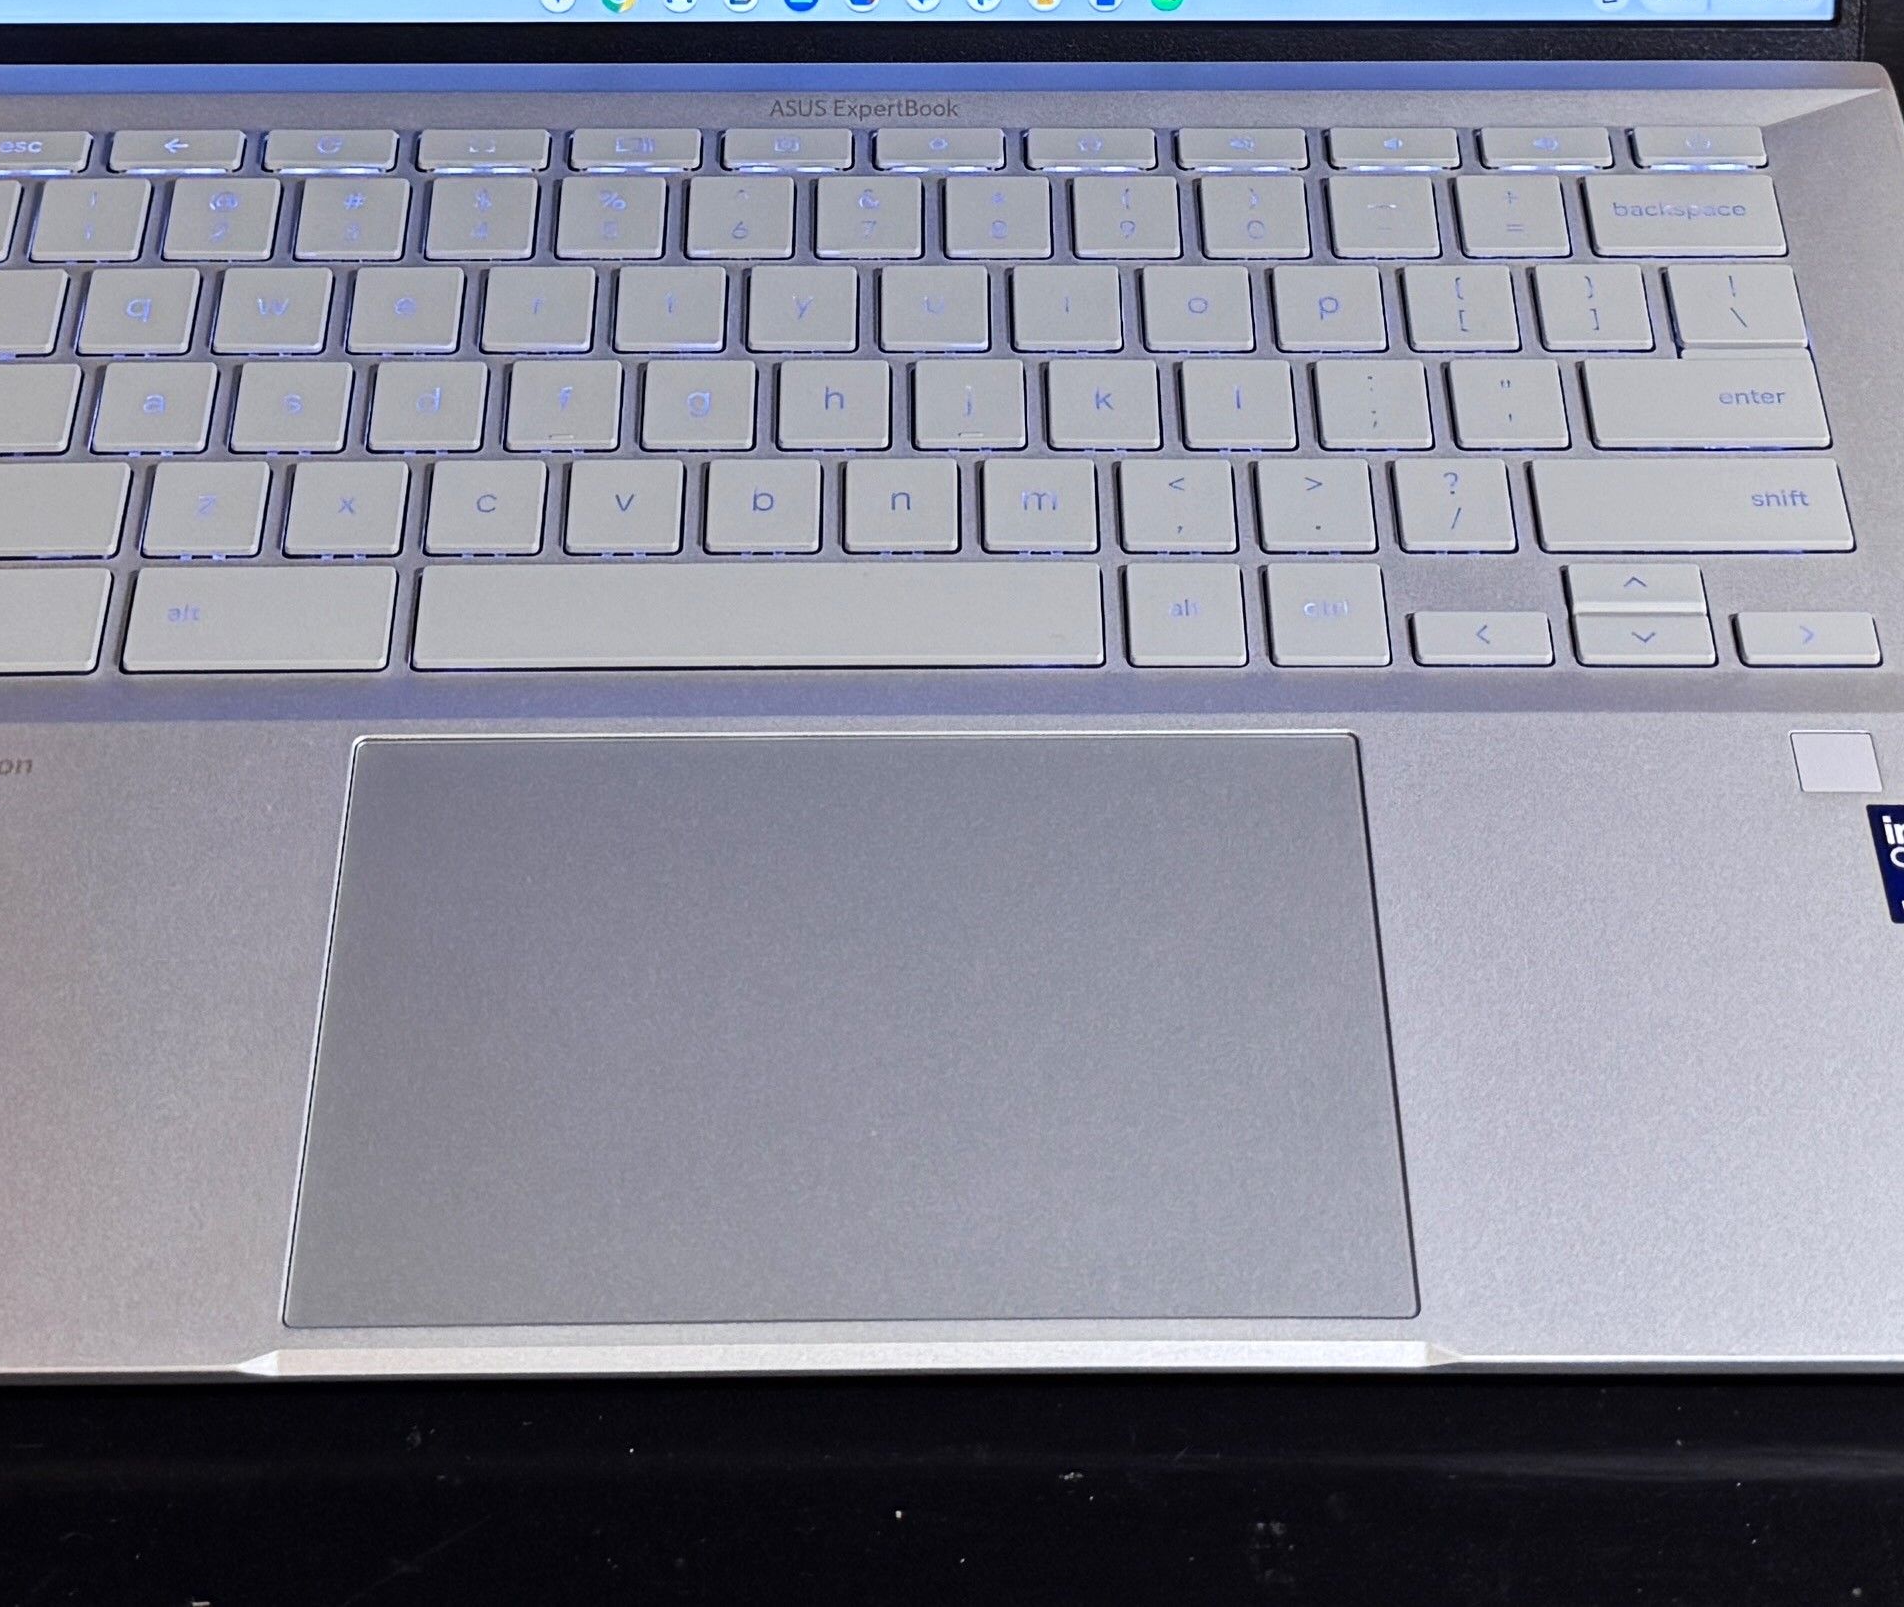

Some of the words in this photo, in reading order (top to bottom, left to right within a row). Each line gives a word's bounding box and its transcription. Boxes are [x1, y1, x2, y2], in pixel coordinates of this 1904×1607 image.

[769, 99, 827, 118] ASUS
[833, 98, 960, 122] ExpertBook
[0, 140, 43, 154] esc
[1612, 200, 1747, 221] backspace
[732, 220, 749, 240] 6
[126, 298, 153, 323] q
[792, 292, 813, 320] y
[1319, 296, 1339, 321] p
[142, 392, 167, 414] a
[416, 387, 442, 414] d
[687, 388, 711, 418] g
[823, 386, 845, 411] h
[1094, 387, 1114, 411] k
[1718, 388, 1786, 405] enter
[1442, 472, 1460, 496] ?
[337, 495, 356, 515] x
[476, 492, 498, 514] c
[615, 492, 636, 514] v
[751, 486, 775, 513] b
[890, 490, 912, 513] n
[1020, 490, 1058, 512] m
[1750, 488, 1810, 508] shift
